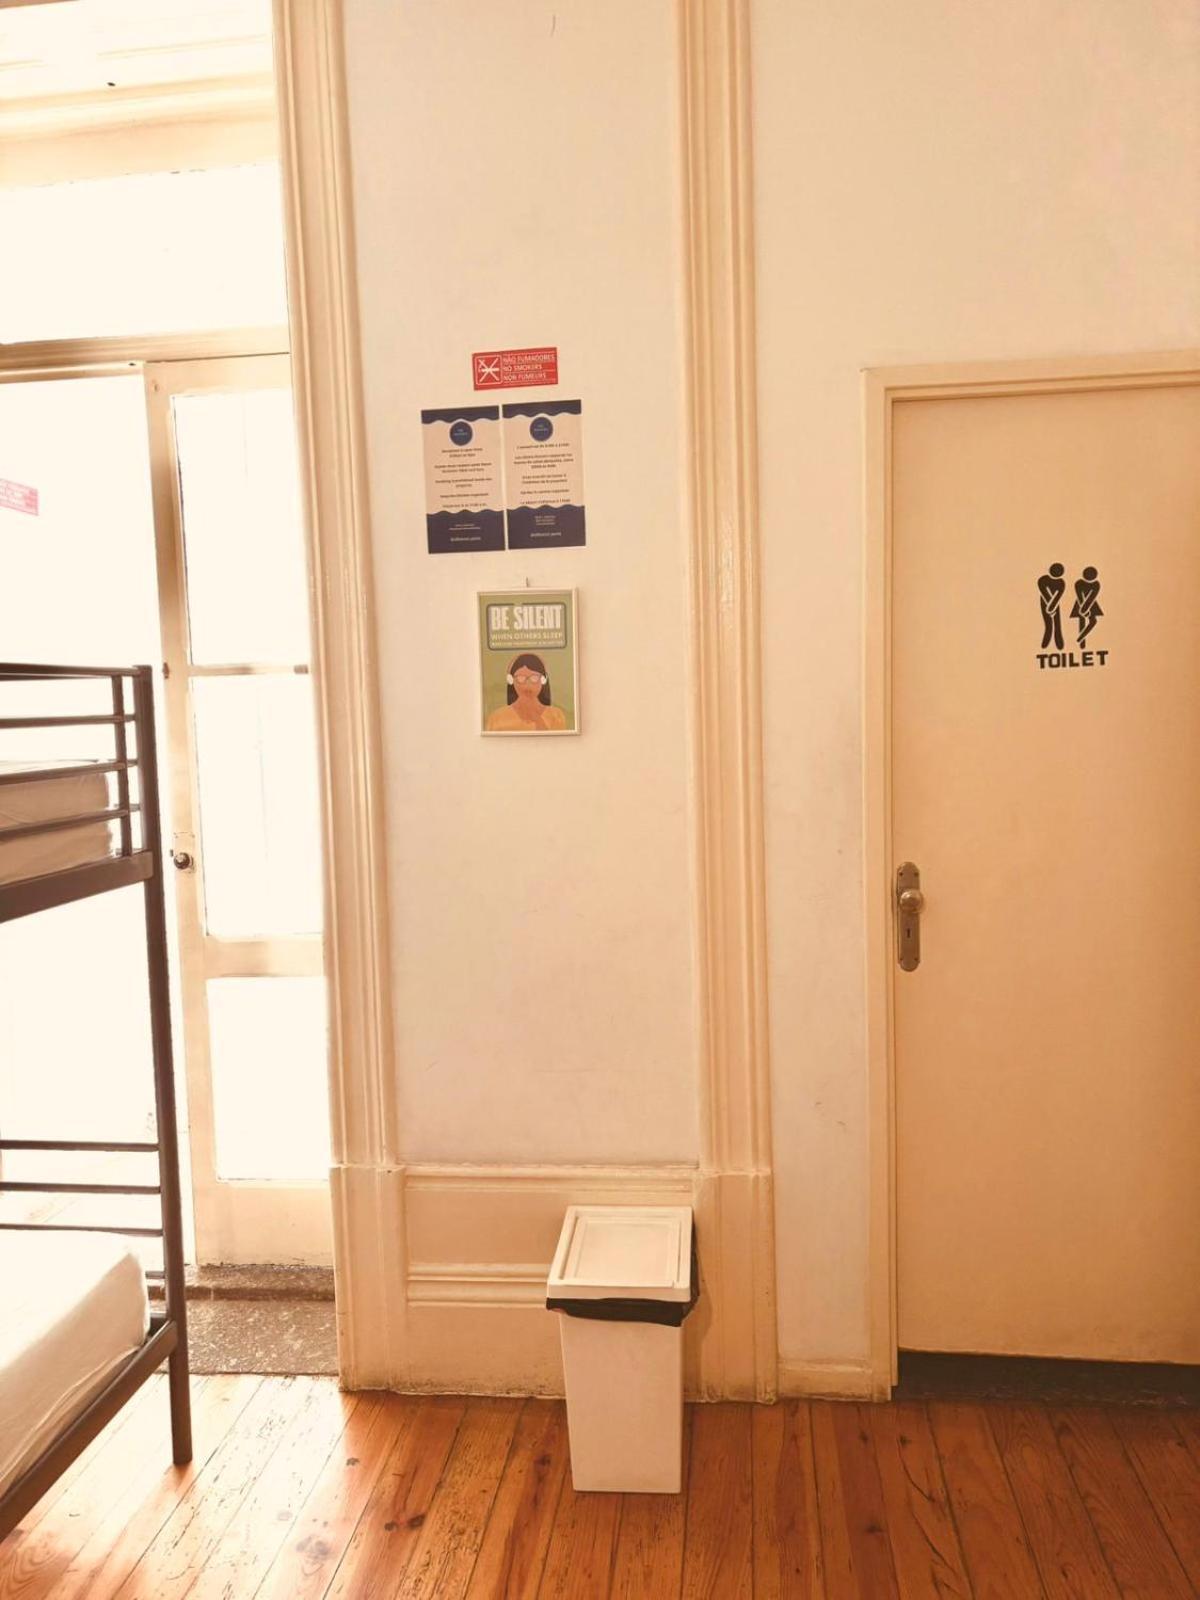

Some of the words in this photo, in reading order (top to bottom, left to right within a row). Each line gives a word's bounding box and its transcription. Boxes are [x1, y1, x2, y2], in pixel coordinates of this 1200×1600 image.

[491, 607, 510, 630] BE
[513, 605, 562, 630] SILENT
[491, 633, 512, 641] WHEN
[513, 632, 541, 640] OTHERS
[542, 631, 563, 639] SLEEP
[1036, 650, 1109, 669] TOILET
